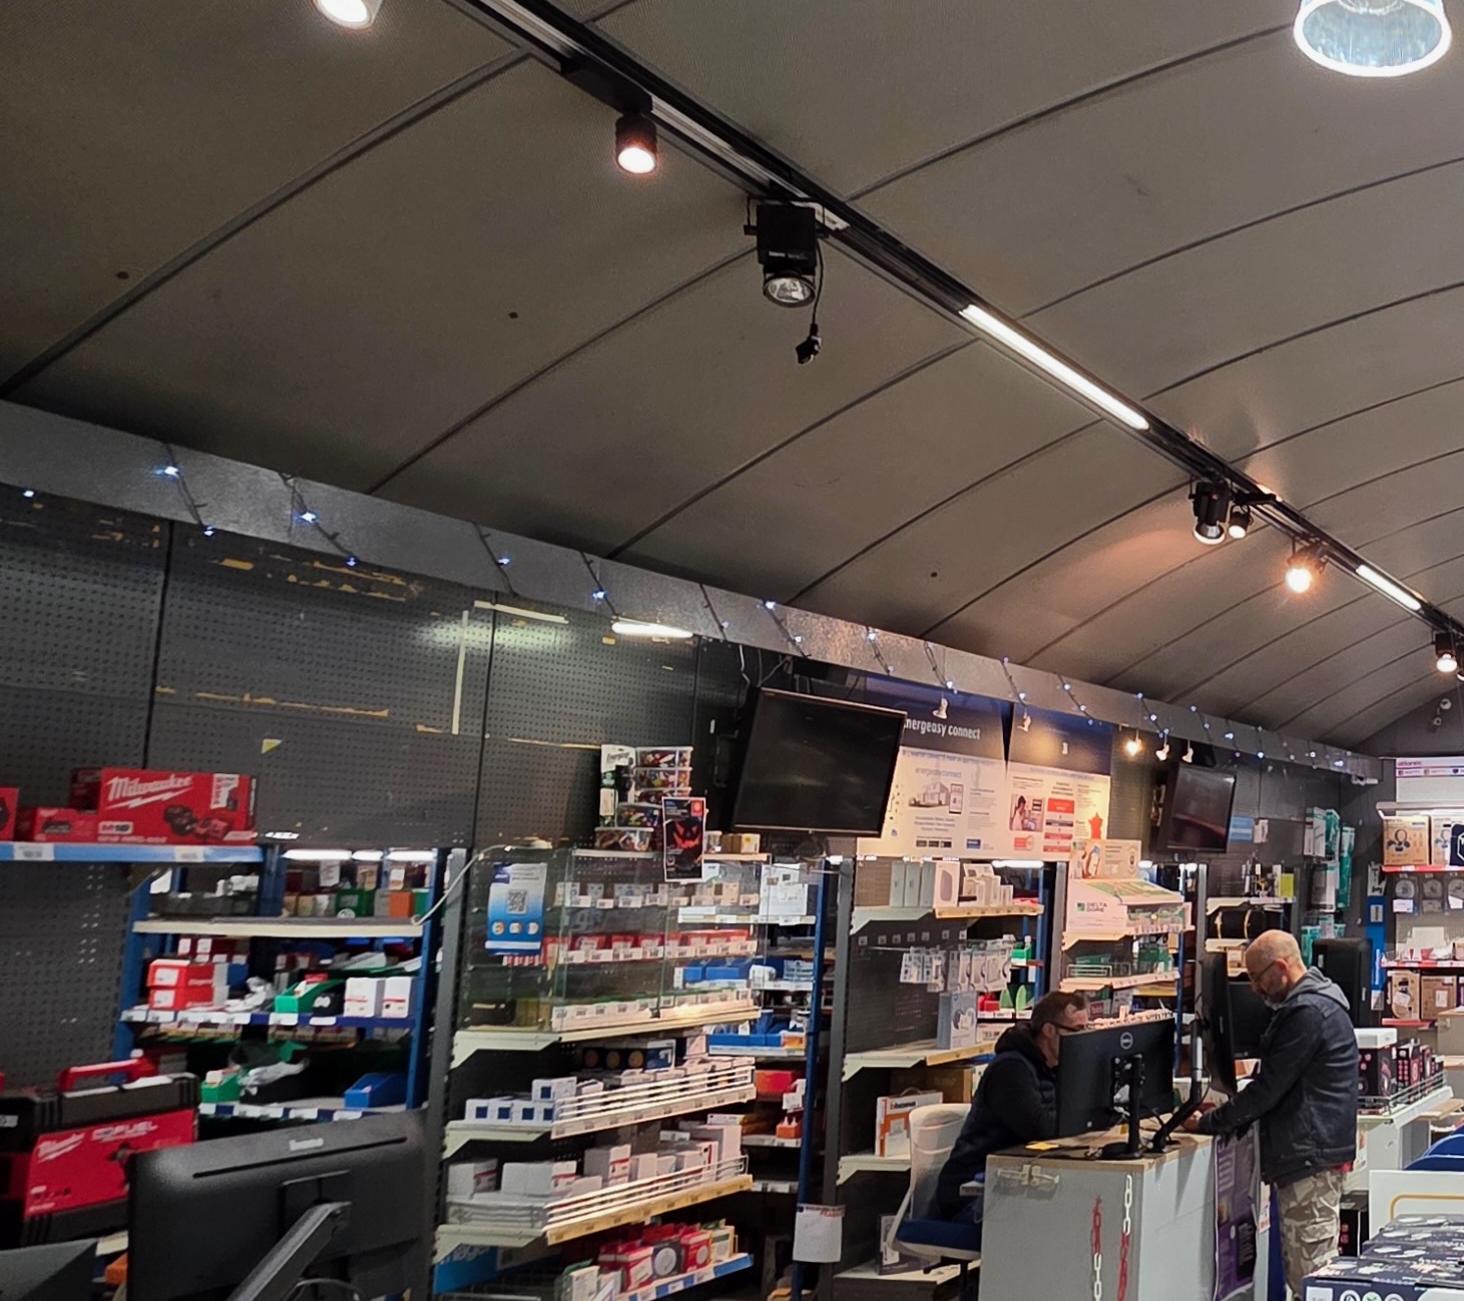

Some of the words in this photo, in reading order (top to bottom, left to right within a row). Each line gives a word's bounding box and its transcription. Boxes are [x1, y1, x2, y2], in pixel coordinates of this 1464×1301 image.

[903, 718, 947, 737] nergeasy
[948, 726, 981, 741] connect
[105, 773, 194, 802] Milwaukee
